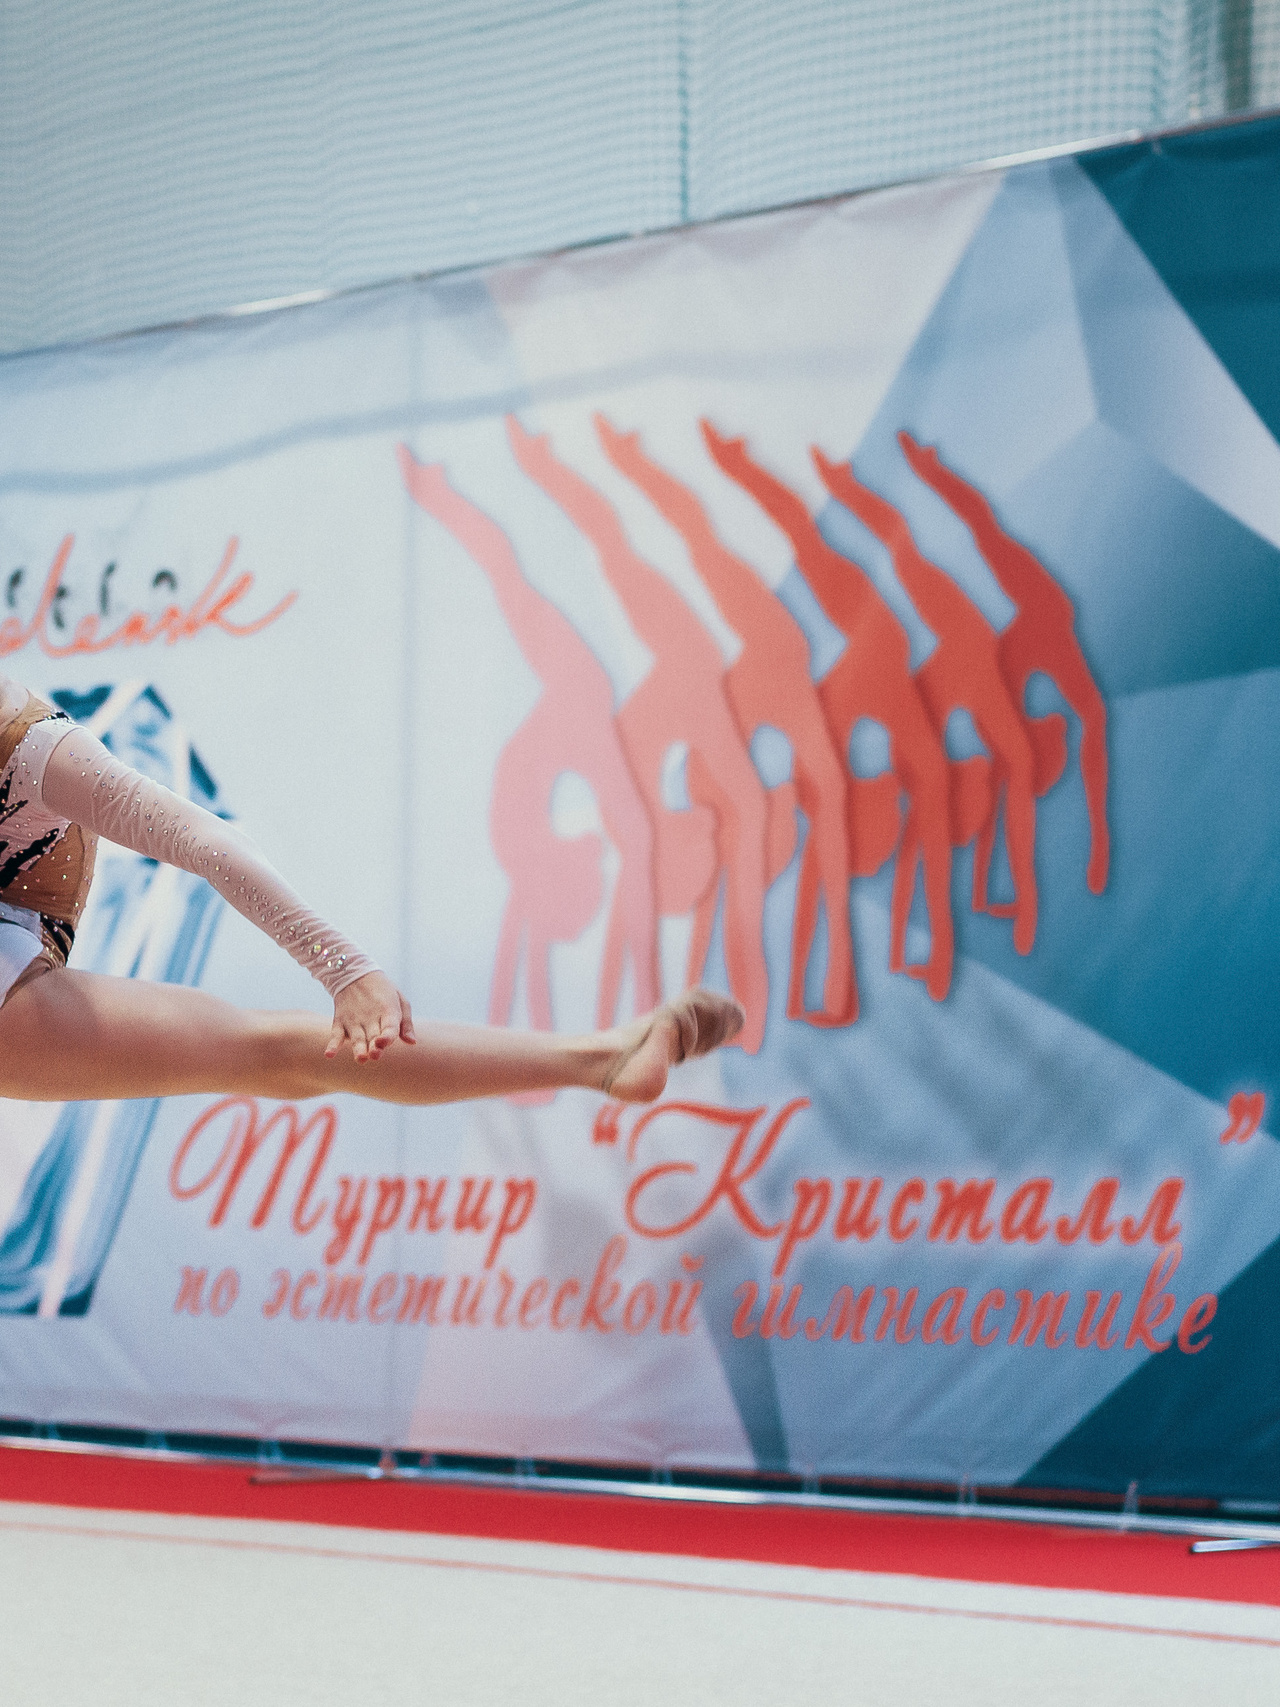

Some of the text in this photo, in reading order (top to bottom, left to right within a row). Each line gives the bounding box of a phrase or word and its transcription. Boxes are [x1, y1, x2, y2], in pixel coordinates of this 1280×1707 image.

[169, 1093, 538, 1270] Турнир
[174, 1234, 1218, 1354] по эстетической гимнастике
